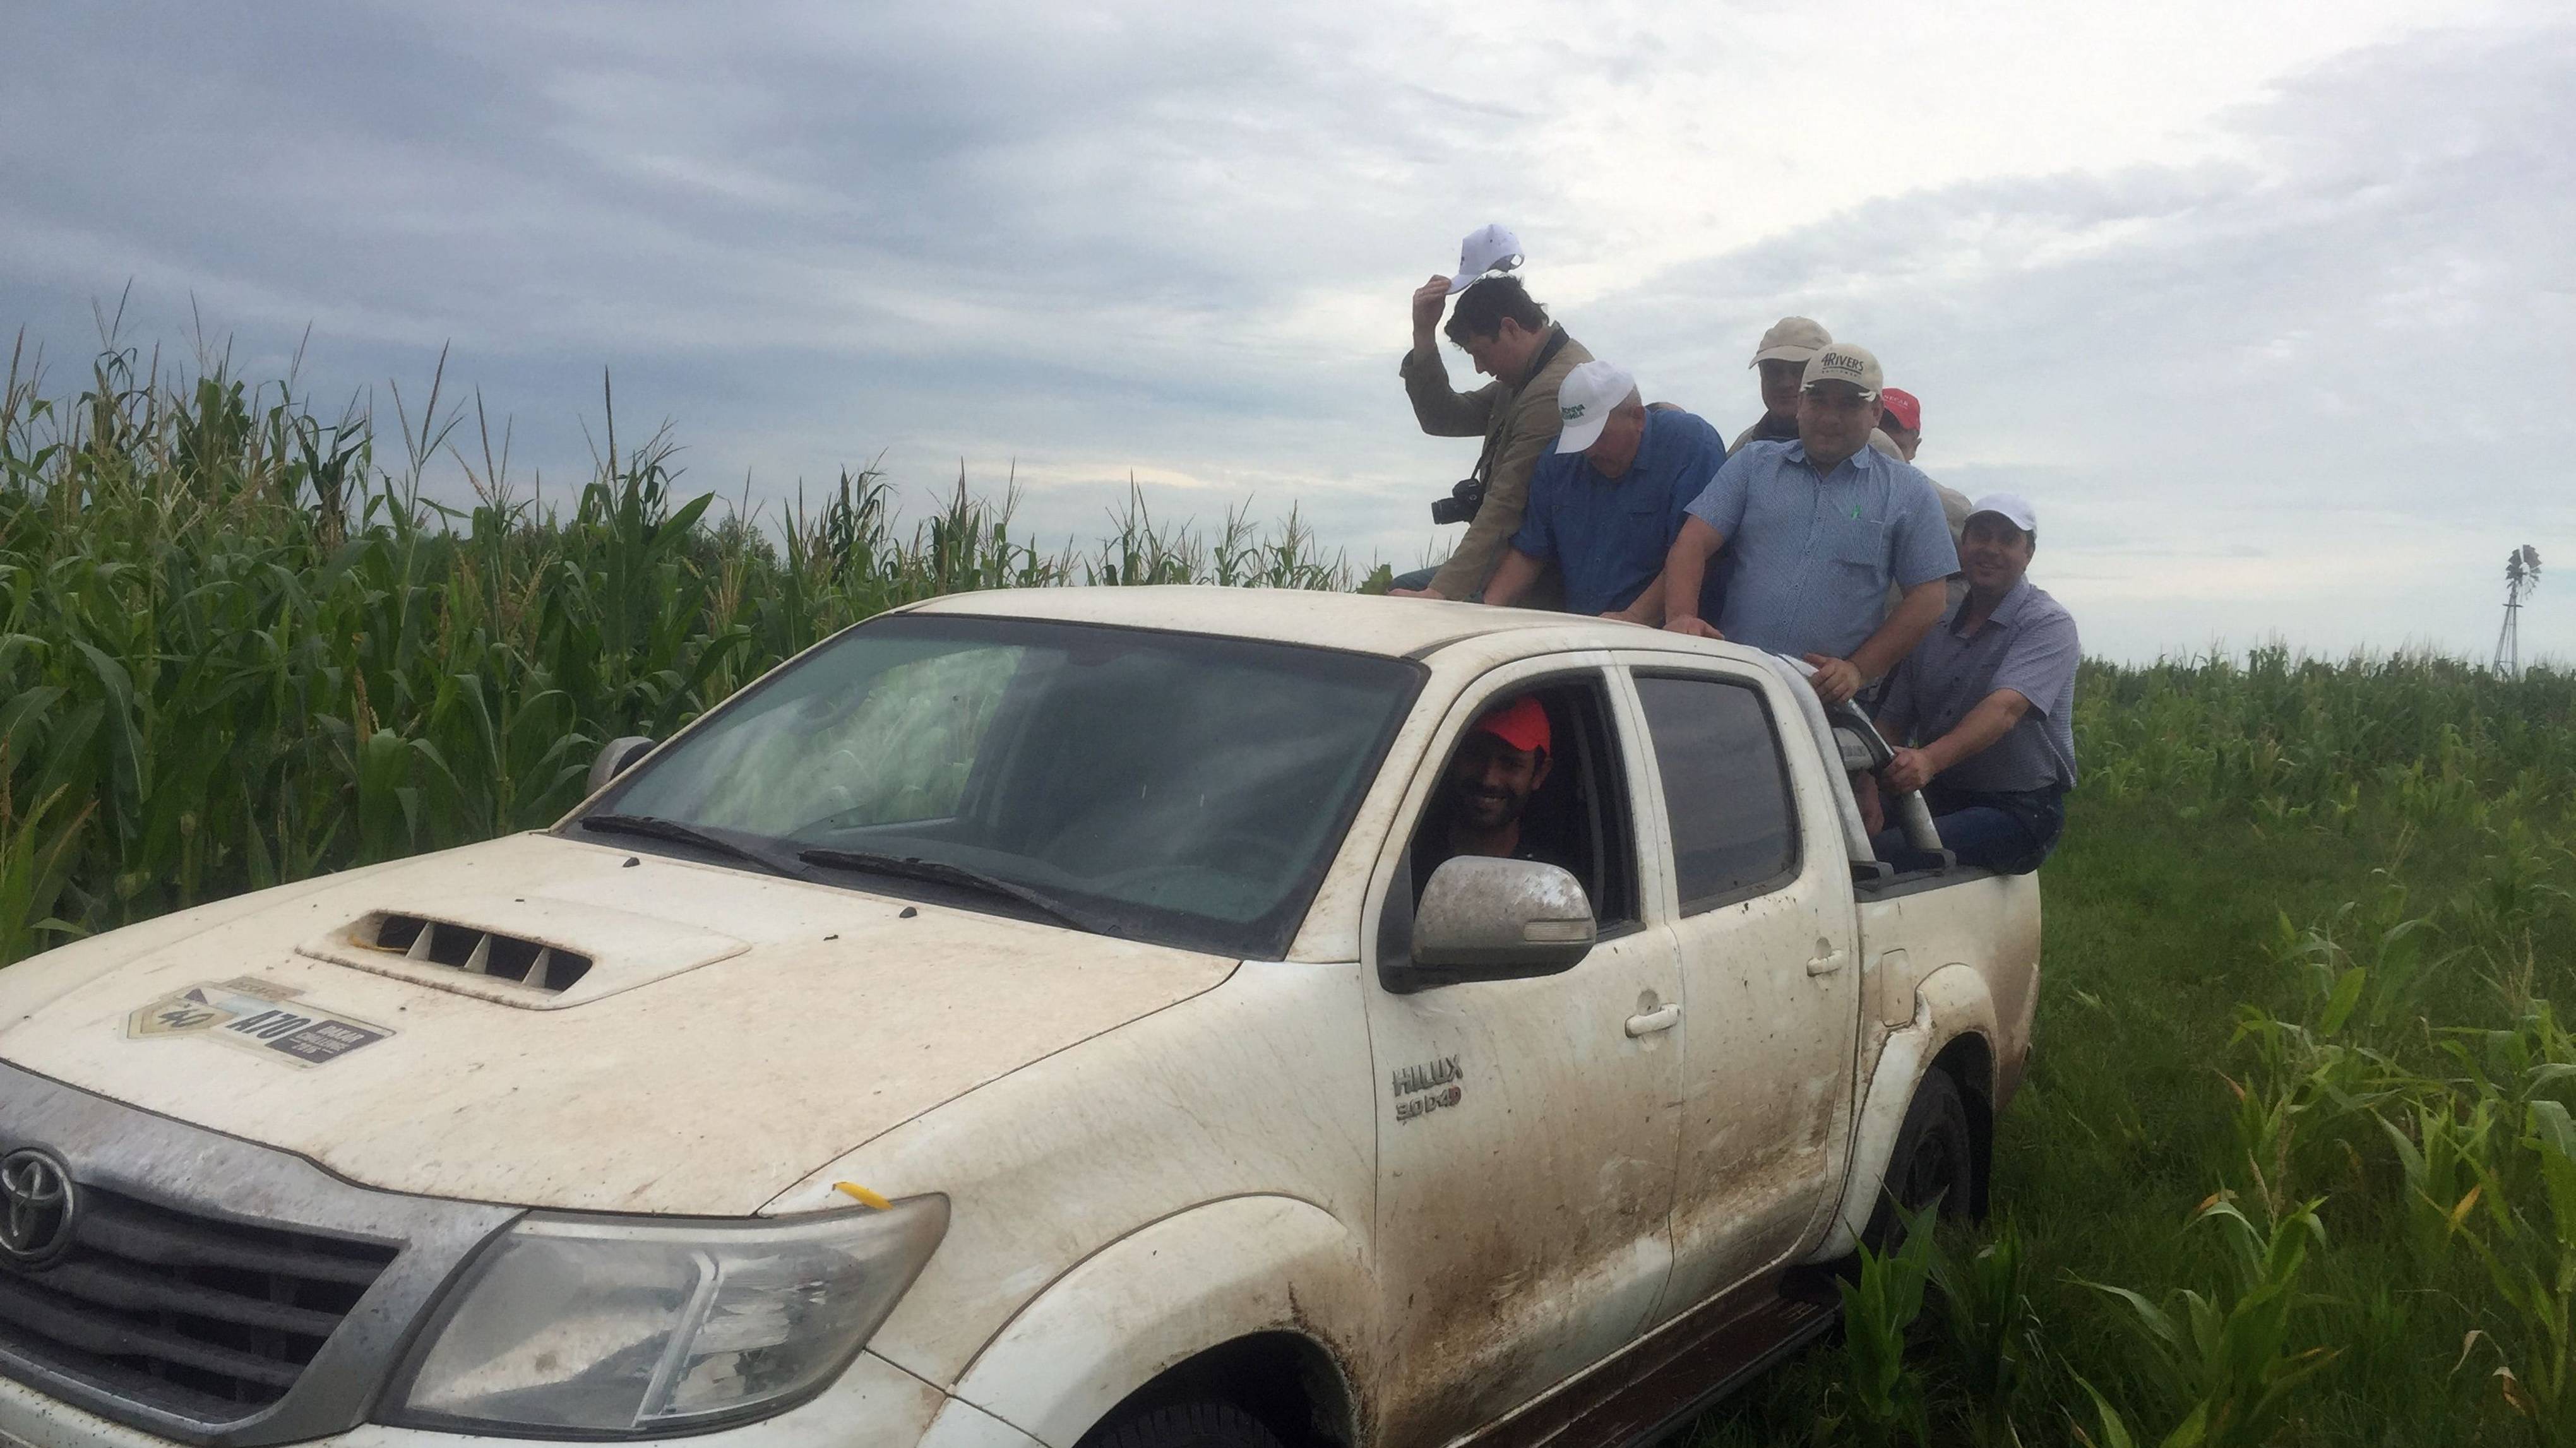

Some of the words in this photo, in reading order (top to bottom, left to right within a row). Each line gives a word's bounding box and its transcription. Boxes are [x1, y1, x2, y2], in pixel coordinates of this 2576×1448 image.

[1821, 352, 1864, 372] 4RIVERS
[225, 1009, 312, 1039] A70
[316, 1025, 365, 1043] DAKAR
[1392, 1055, 1464, 1097] HILUX
